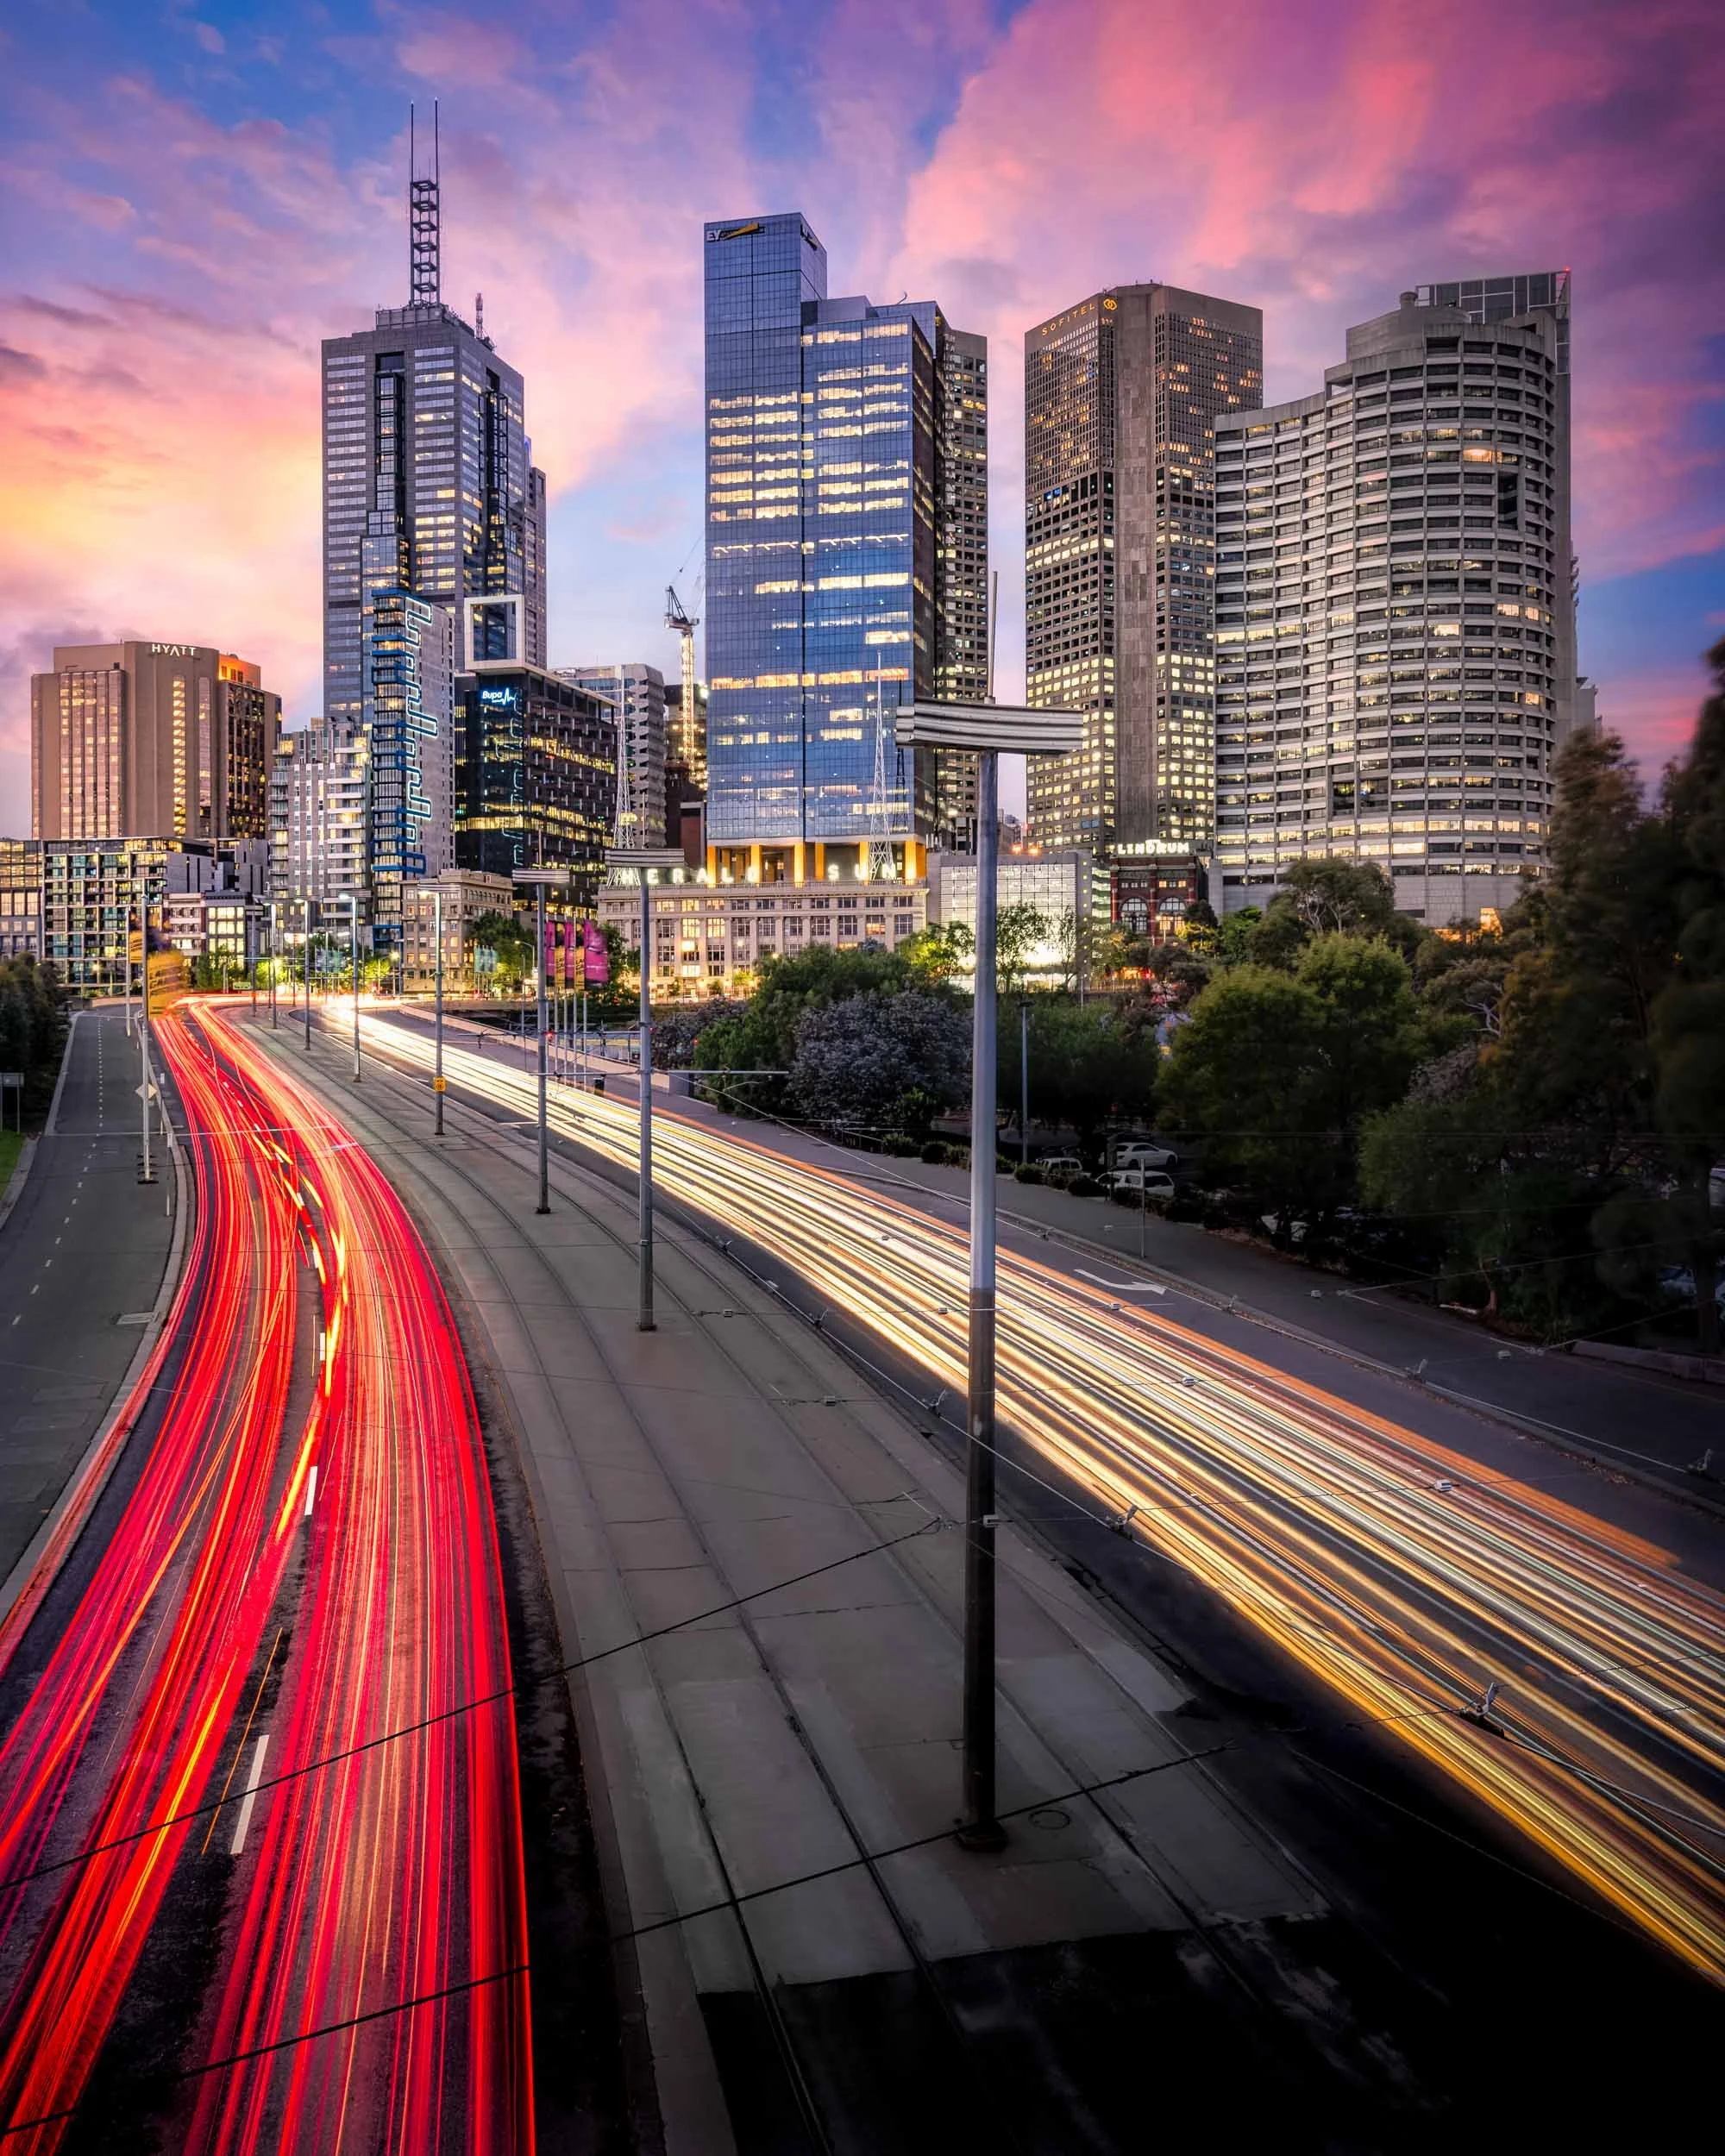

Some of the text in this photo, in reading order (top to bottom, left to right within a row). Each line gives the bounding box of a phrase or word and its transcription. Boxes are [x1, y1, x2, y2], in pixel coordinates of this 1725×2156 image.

[1042, 304, 1095, 335] SOFITEL
[152, 643, 197, 657] HYATT
[482, 691, 503, 699] Bupa
[1118, 842, 1189, 855] LINDRUM
[622, 864, 897, 885] HERALD SUN
